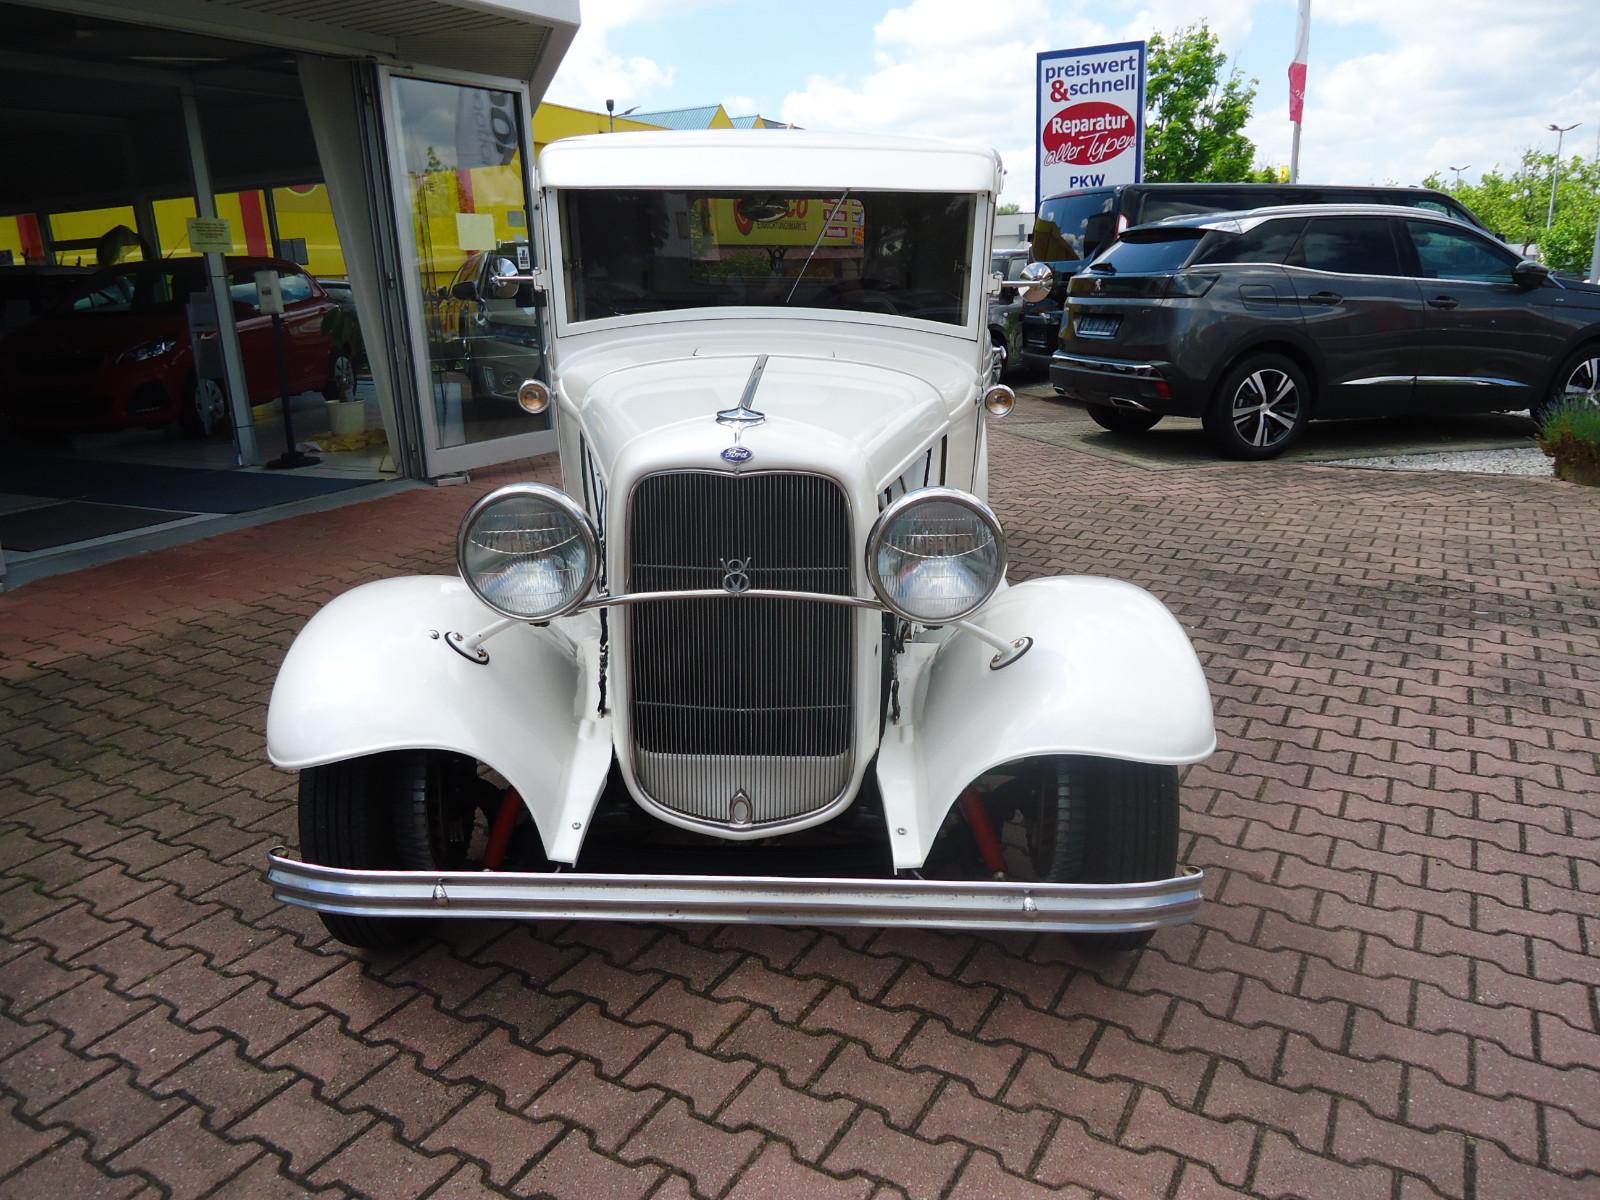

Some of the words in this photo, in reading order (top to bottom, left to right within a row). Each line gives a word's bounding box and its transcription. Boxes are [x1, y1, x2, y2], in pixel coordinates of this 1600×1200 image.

[1045, 55, 1137, 83] preiswert
[1052, 113, 1129, 136] Reparatur
[1044, 142, 1085, 166] aller
[1079, 131, 1136, 162] Typen
[1070, 174, 1106, 188] PKW
